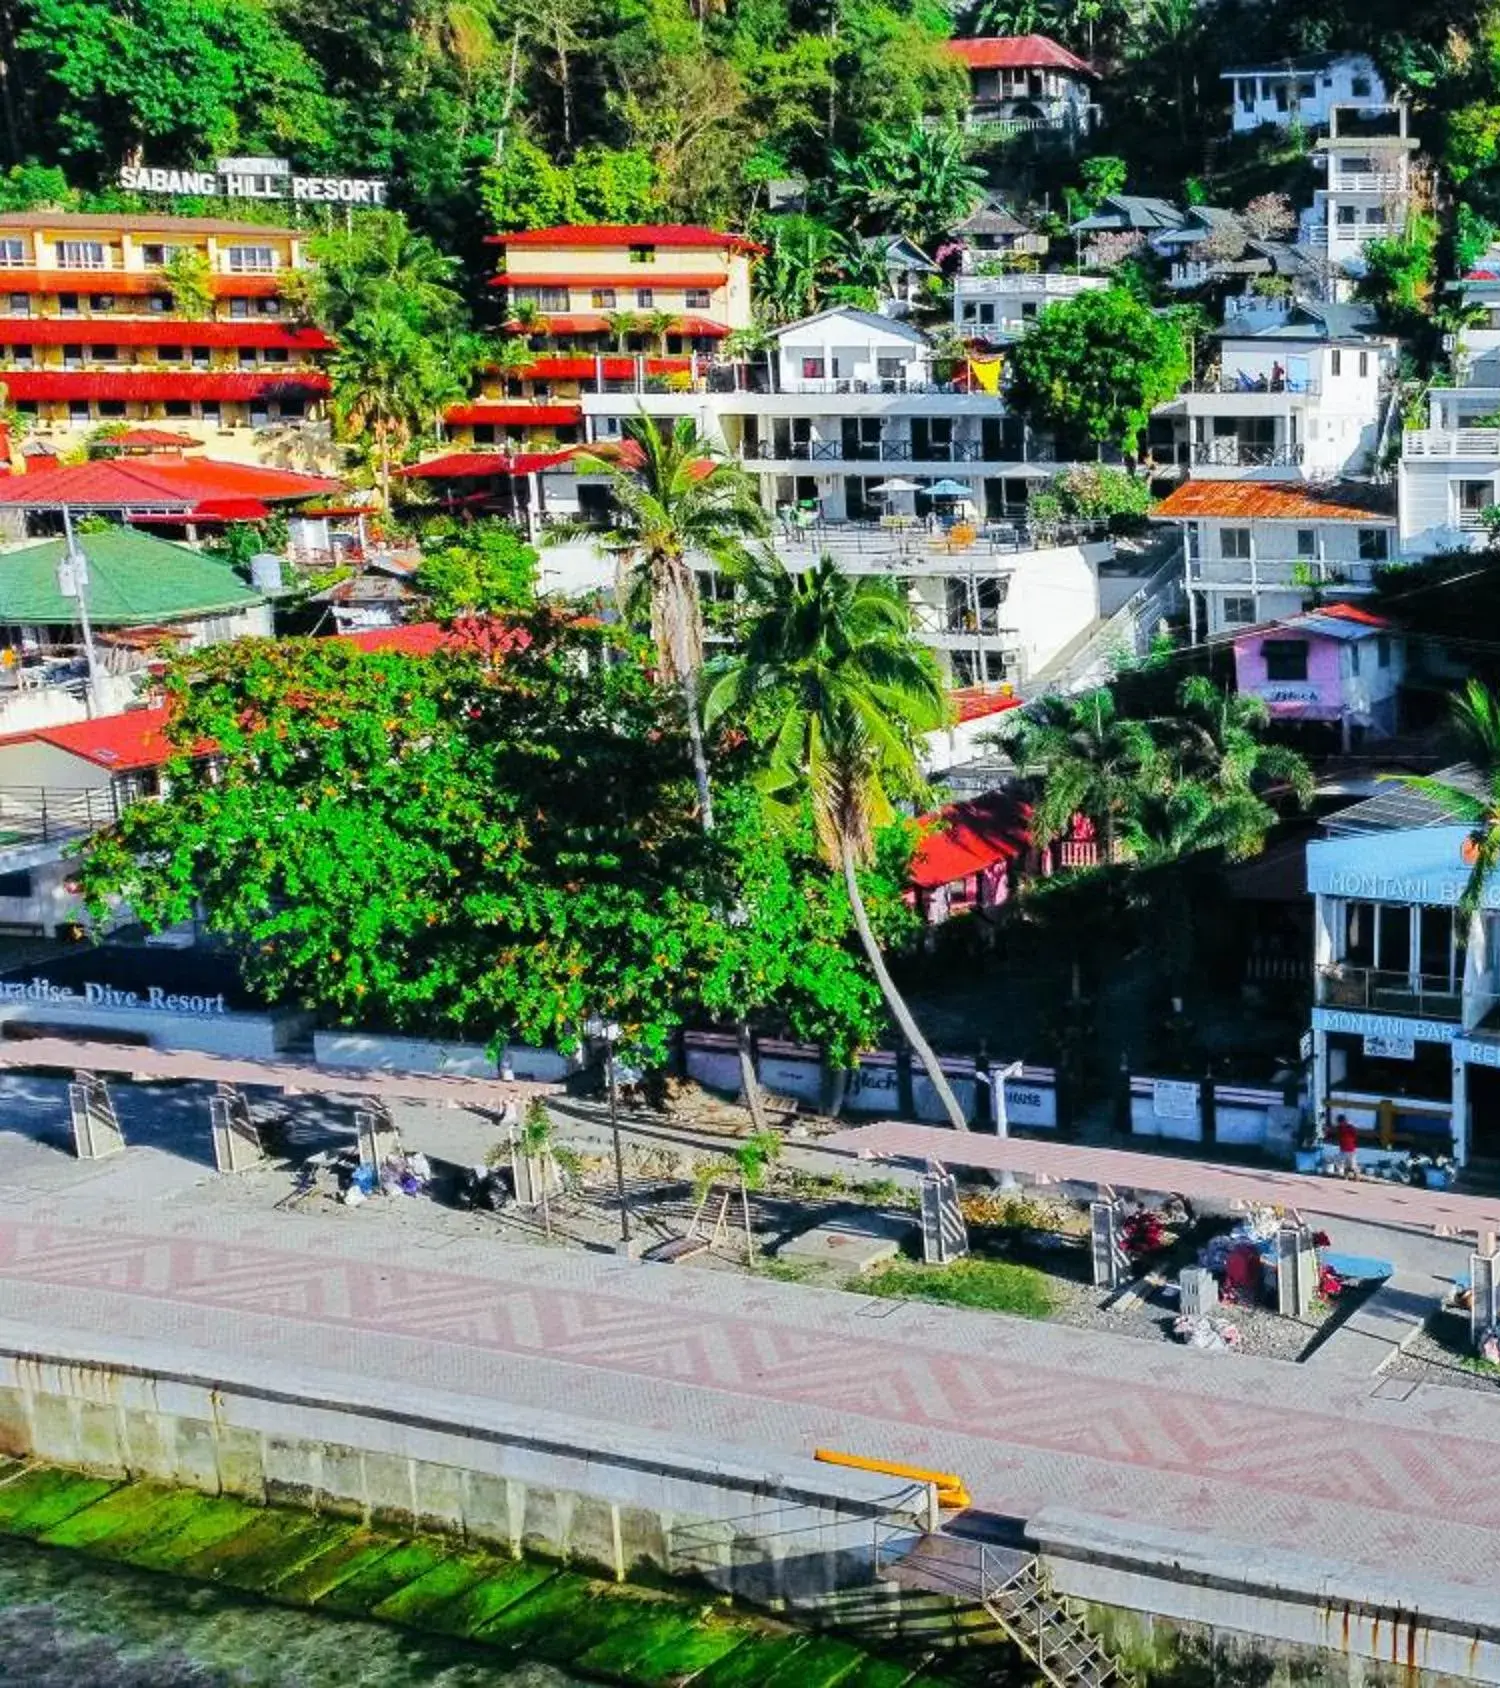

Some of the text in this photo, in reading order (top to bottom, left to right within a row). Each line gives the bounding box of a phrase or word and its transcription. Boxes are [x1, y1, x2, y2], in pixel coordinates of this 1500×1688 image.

[119, 166, 384, 204] SABANG HILL RESORT
[1329, 872, 1428, 899] MONTANI
[84, 982, 138, 1007] Dive
[148, 986, 224, 1013] Resort
[1324, 1011, 1453, 1040] MONTANI BAR
